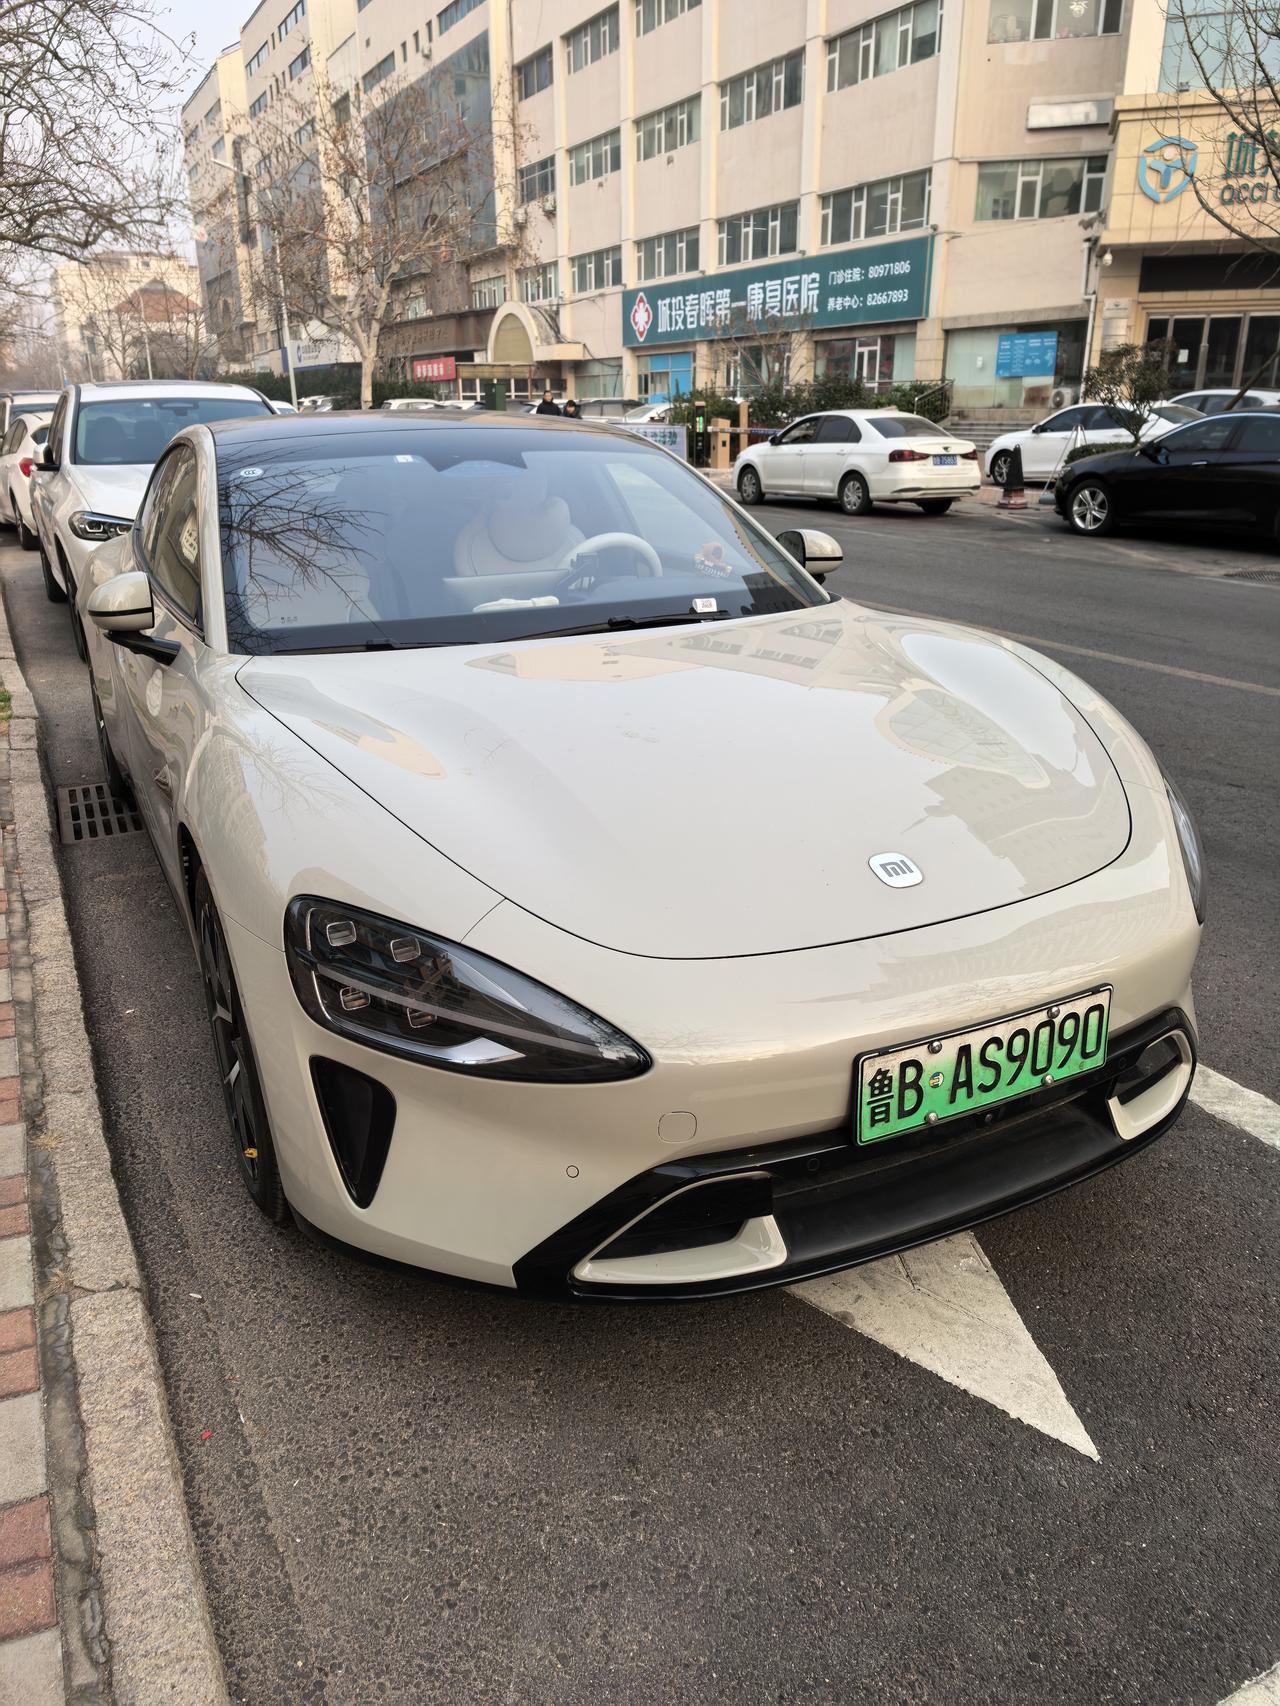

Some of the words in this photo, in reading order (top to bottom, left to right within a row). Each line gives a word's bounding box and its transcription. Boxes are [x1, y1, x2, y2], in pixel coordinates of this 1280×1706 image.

[657, 272, 820, 333] 城投春晖第一康复医院
